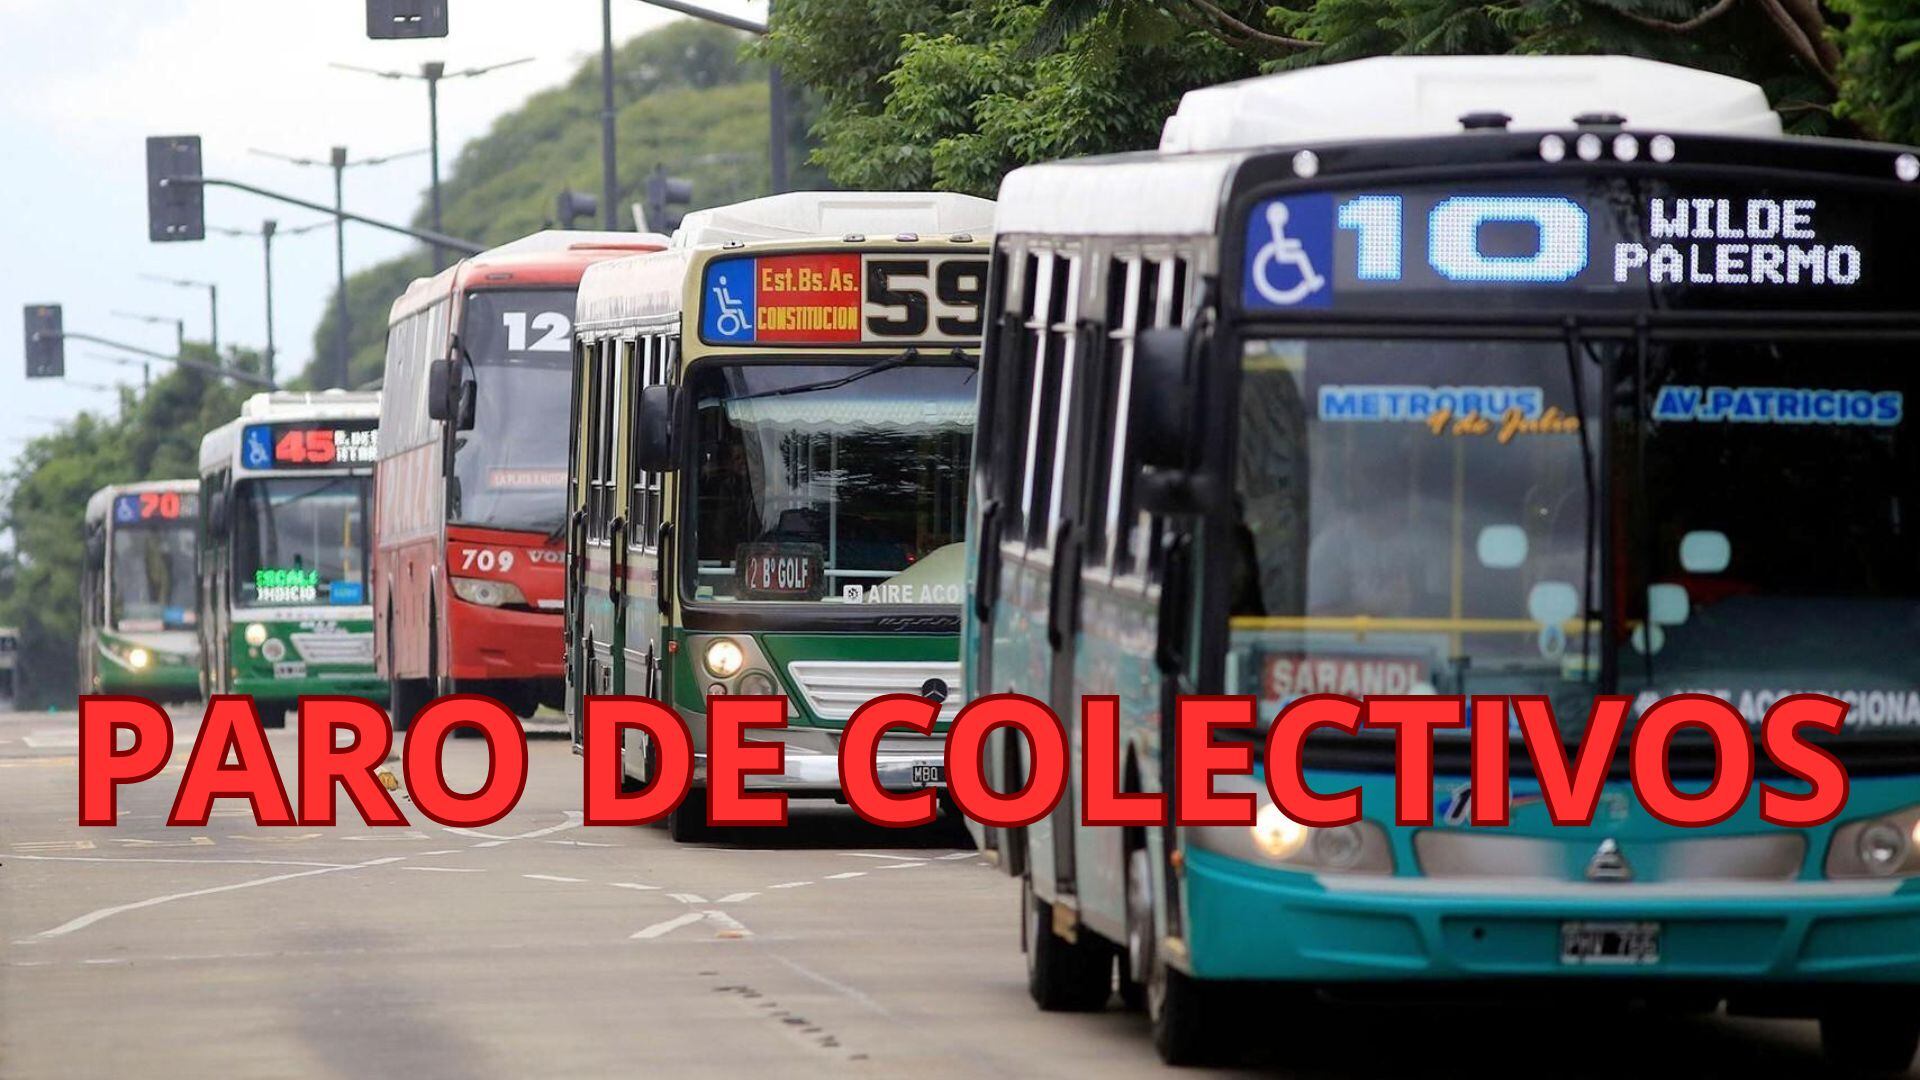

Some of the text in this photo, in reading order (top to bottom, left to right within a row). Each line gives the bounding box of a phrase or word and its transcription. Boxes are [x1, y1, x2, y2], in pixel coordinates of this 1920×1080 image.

[1650, 198, 1816, 239] WILDE
[1337, 195, 1590, 282] 10
[1614, 243, 1861, 284] PALERMO
[866, 259, 990, 337] 59
[757, 306, 858, 331] CONSTITUCION
[1320, 386, 1542, 420] METROBUS
[1652, 386, 1902, 425] AV.PATRICIOS
[1498, 406, 1580, 444] Julio
[275, 430, 336, 462] 45
[140, 492, 180, 519] 70
[462, 549, 515, 572] 709
[778, 558, 809, 589] GOLF
[868, 584, 913, 604] AIRE
